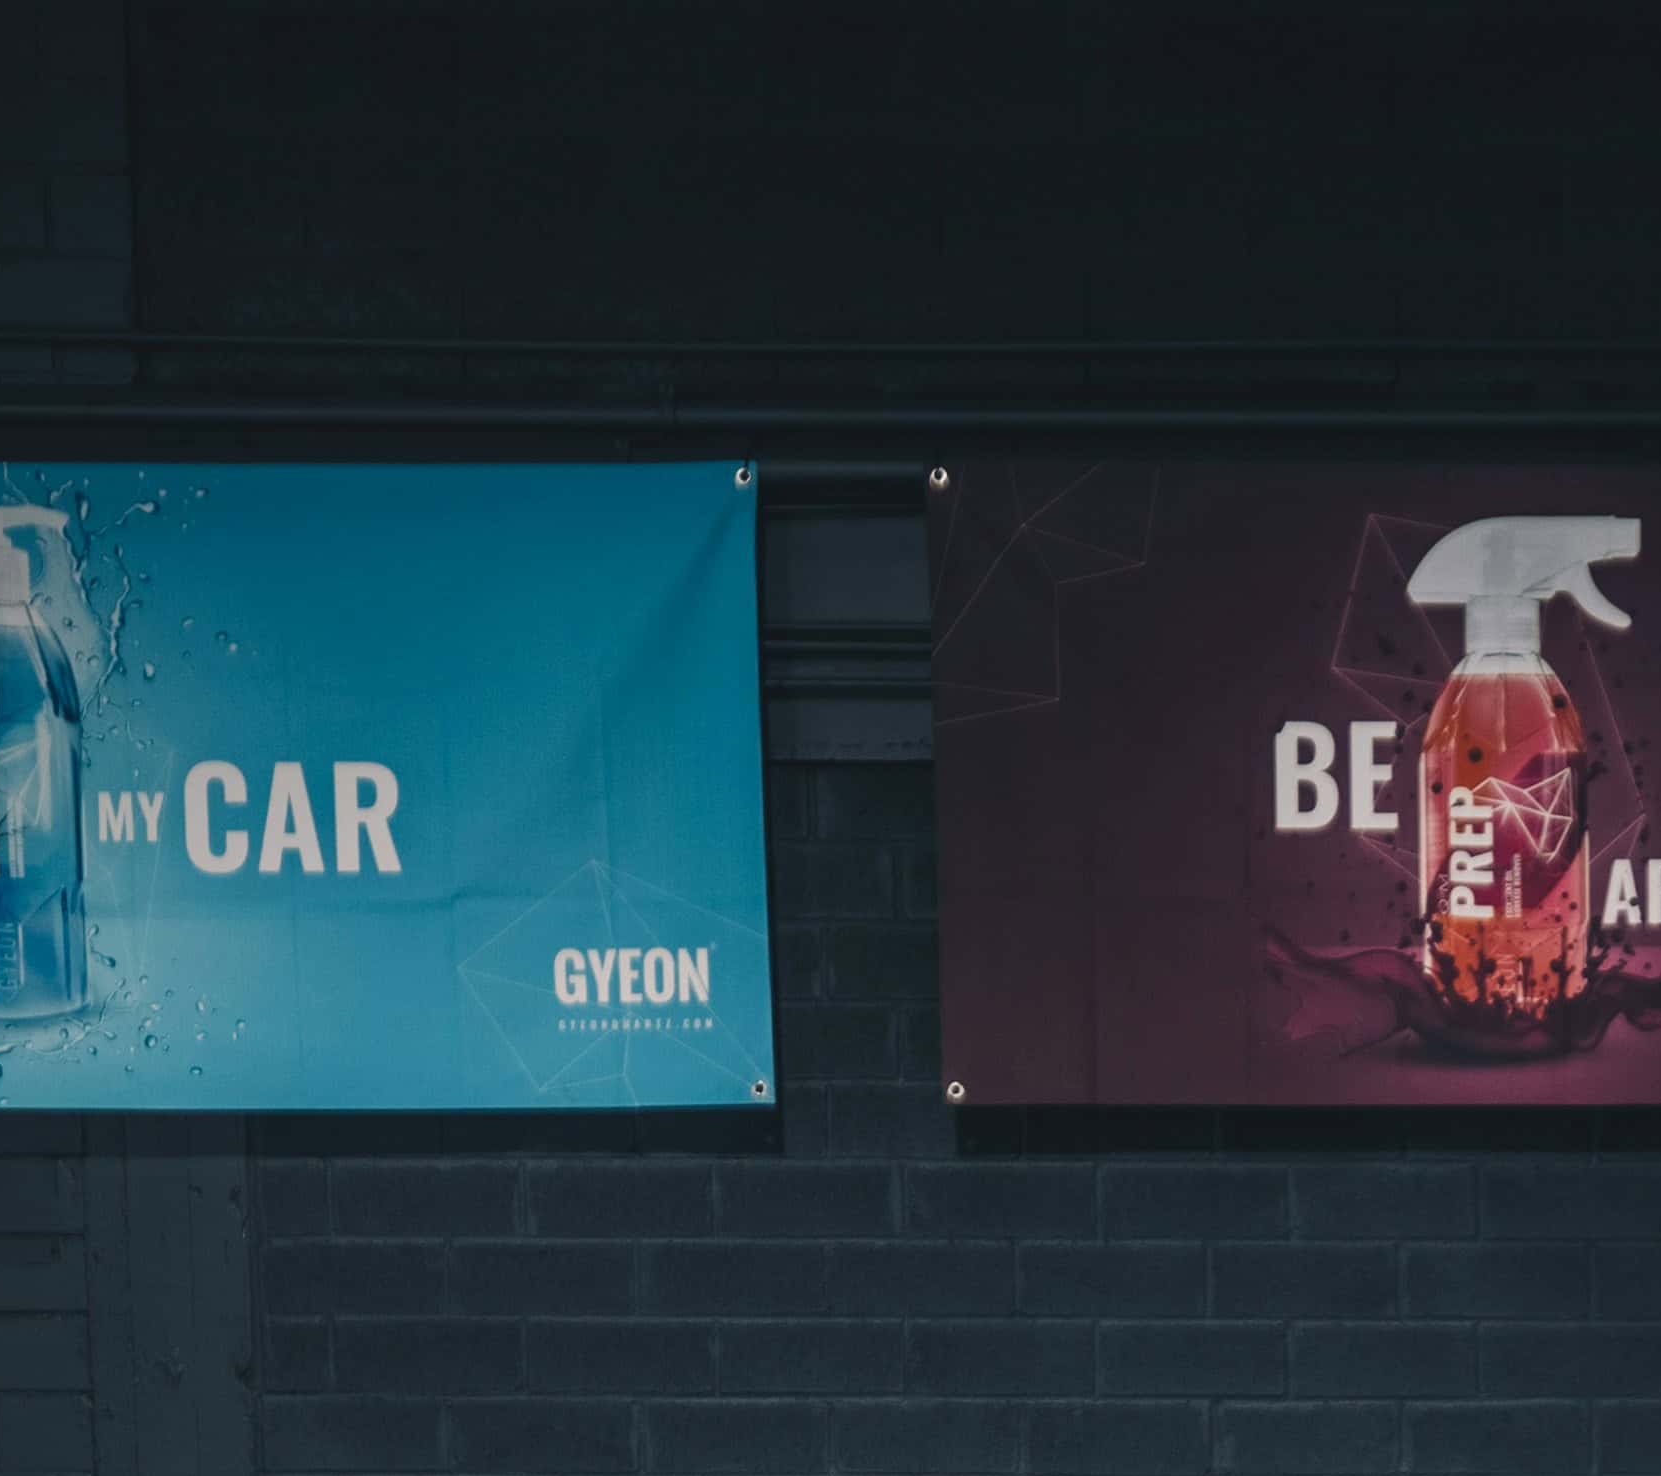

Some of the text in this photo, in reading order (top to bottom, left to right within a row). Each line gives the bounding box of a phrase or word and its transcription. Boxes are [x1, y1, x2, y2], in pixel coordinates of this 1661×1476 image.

[98, 791, 164, 842] MY
[184, 760, 402, 875] CAR
[1275, 720, 1399, 831] BE
[1449, 787, 1494, 919] PREP
[553, 947, 709, 1005] GYEON
